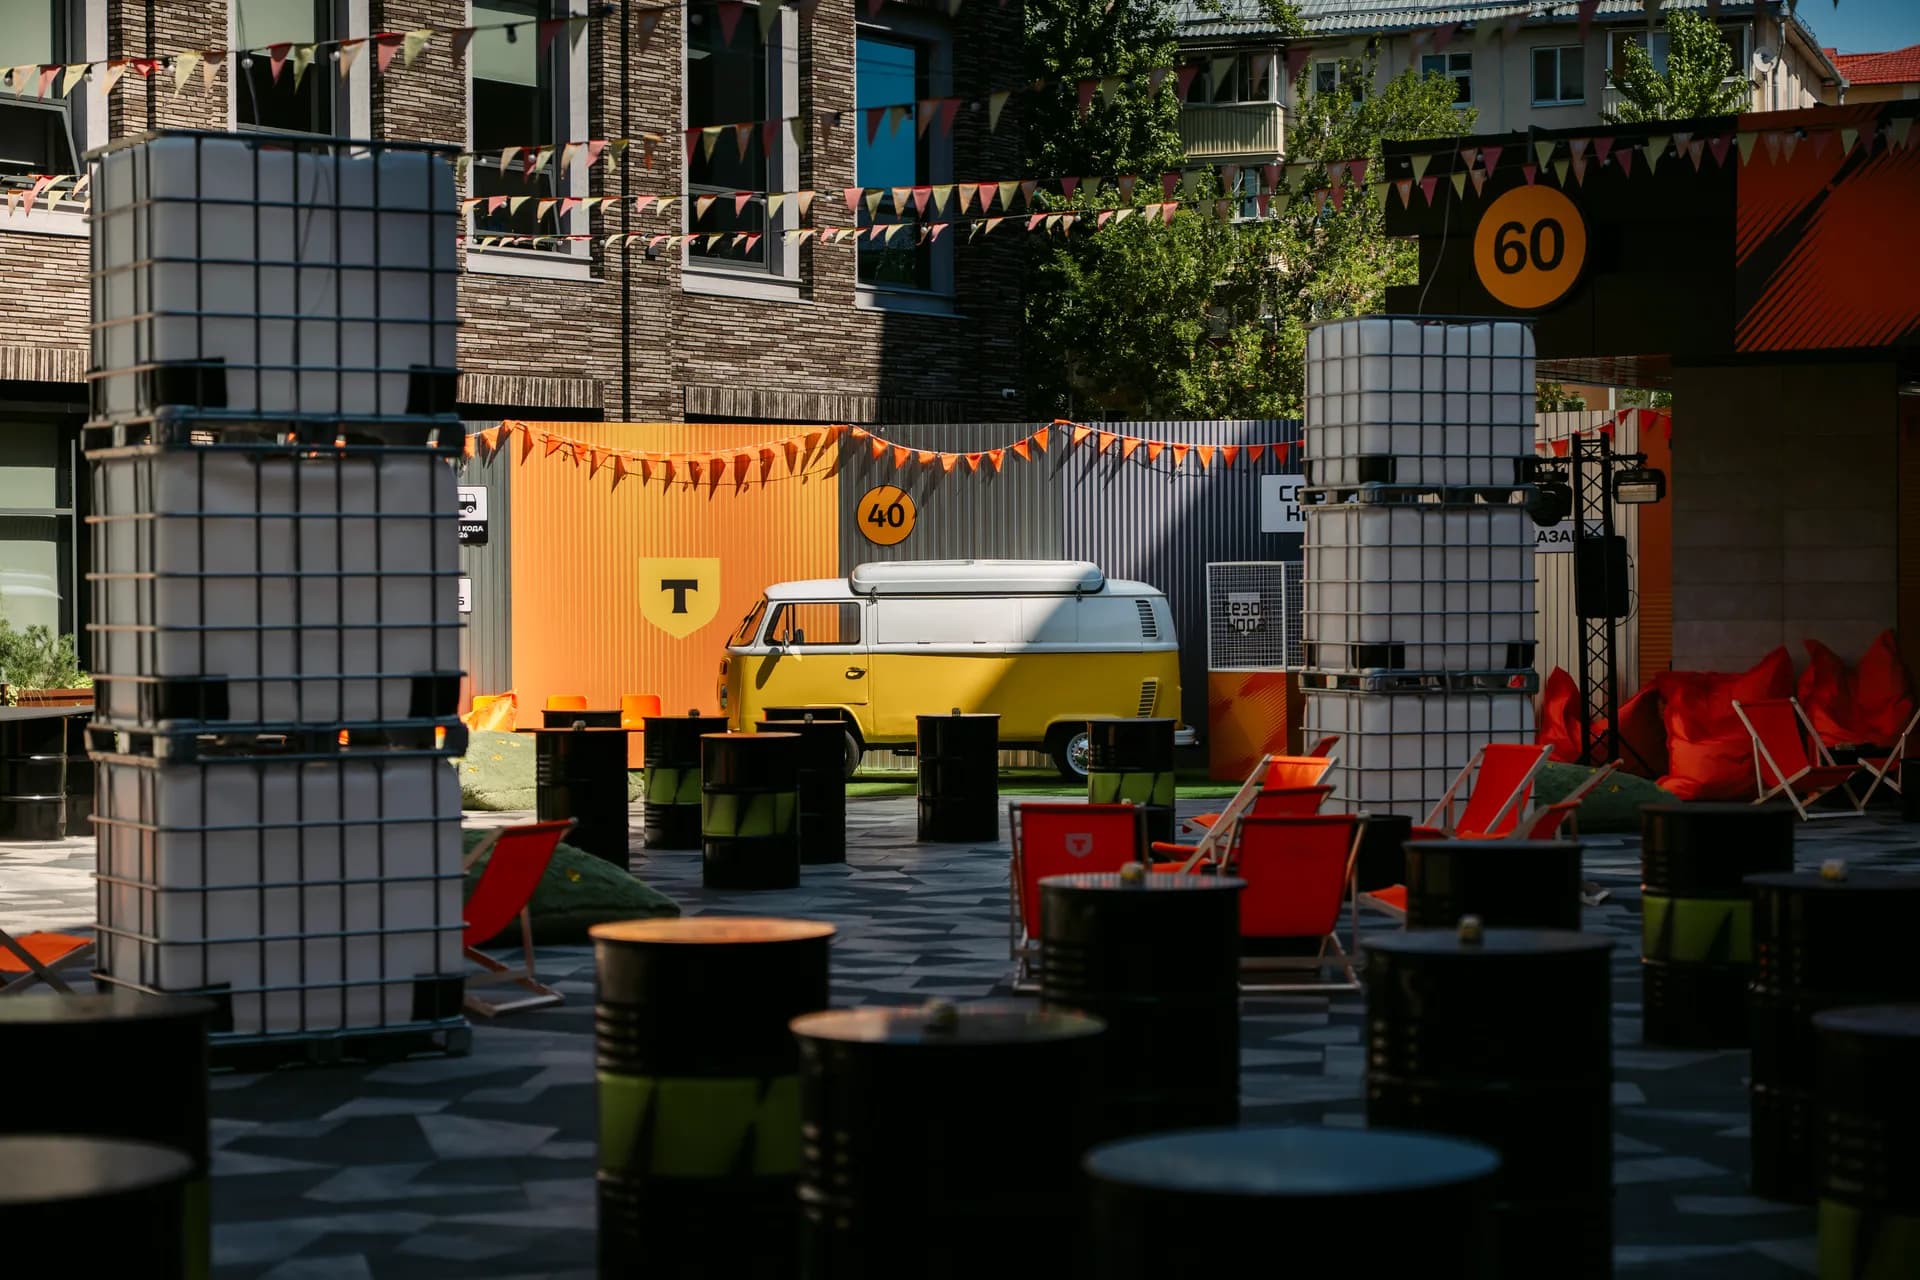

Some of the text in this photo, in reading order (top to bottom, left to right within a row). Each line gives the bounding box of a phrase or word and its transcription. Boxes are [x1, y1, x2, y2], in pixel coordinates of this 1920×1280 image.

[1494, 217, 1565, 275] 60
[461, 525, 484, 533] КОДА
[868, 503, 905, 528] 40
[661, 579, 699, 614] T
